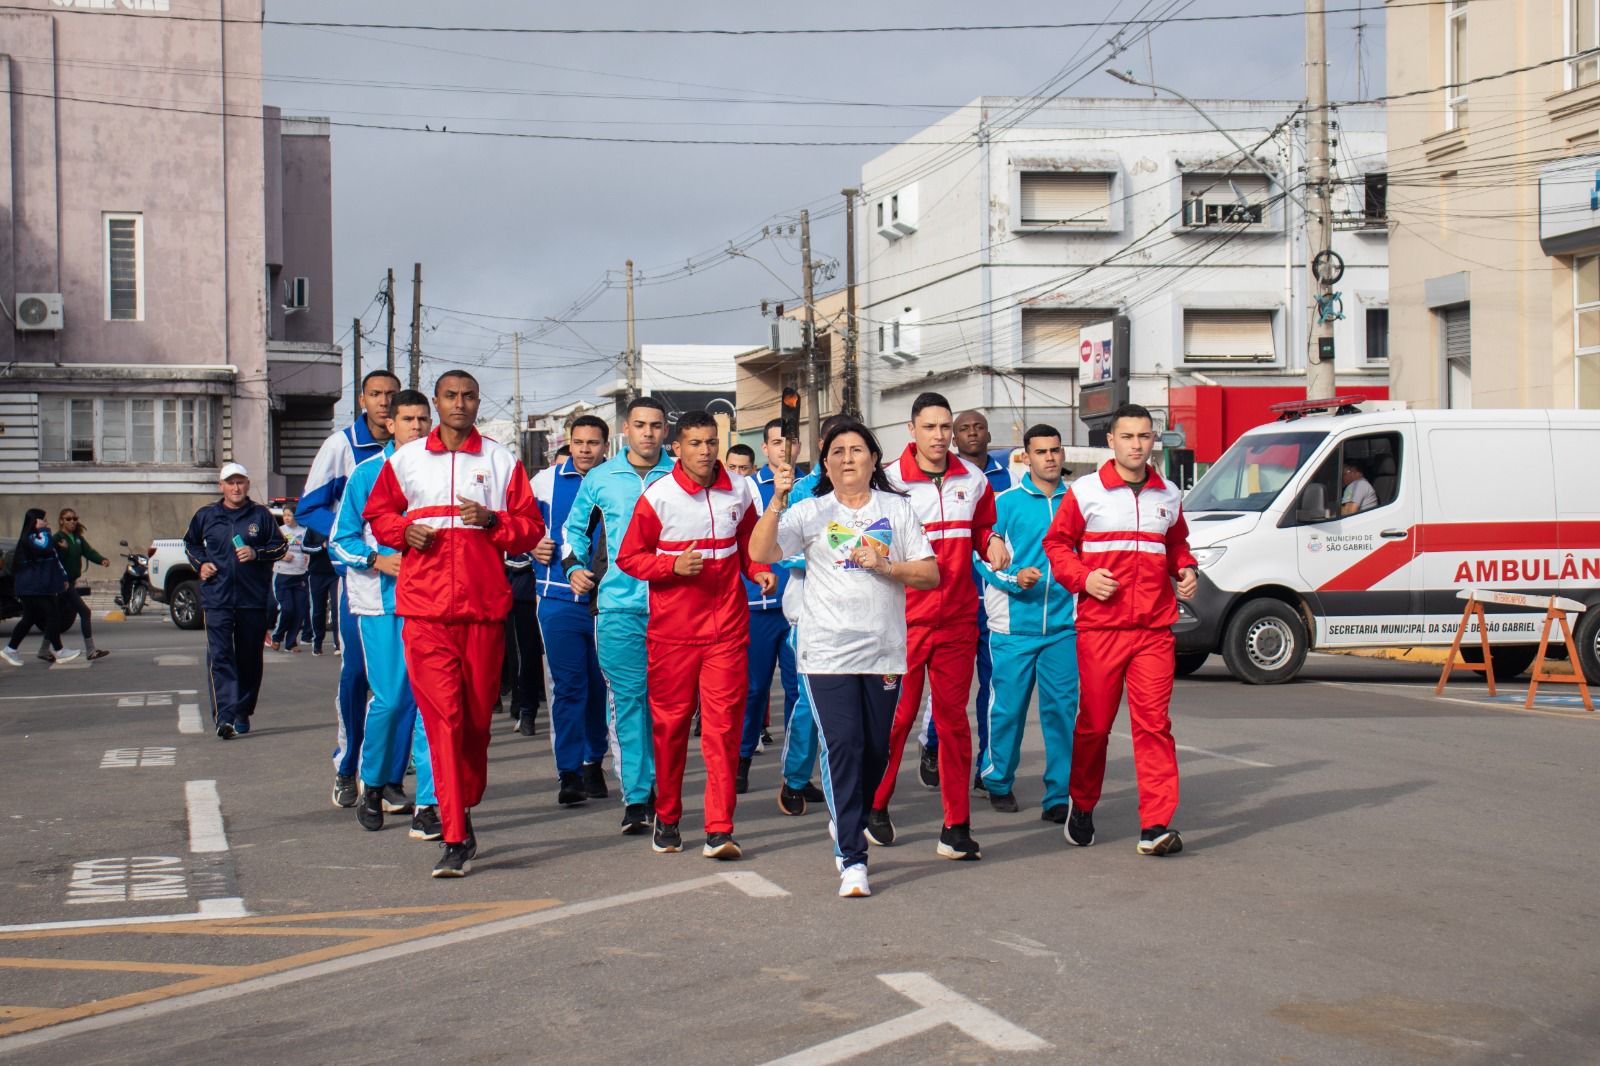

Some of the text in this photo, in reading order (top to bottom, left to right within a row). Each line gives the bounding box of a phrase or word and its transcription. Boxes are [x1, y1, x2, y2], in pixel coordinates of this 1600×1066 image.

[1326, 543, 1373, 552] SÃO GABRIEL
[1453, 553, 1600, 582] AMBULÂN
[1329, 625, 1378, 635] SECRETARIA
[1380, 624, 1426, 634] MUNICIPAL
[1429, 624, 1439, 633] DA
[1442, 622, 1468, 633] SAÚE
[1502, 622, 1535, 632] GABRIEL
[65, 856, 188, 904] MOTO
